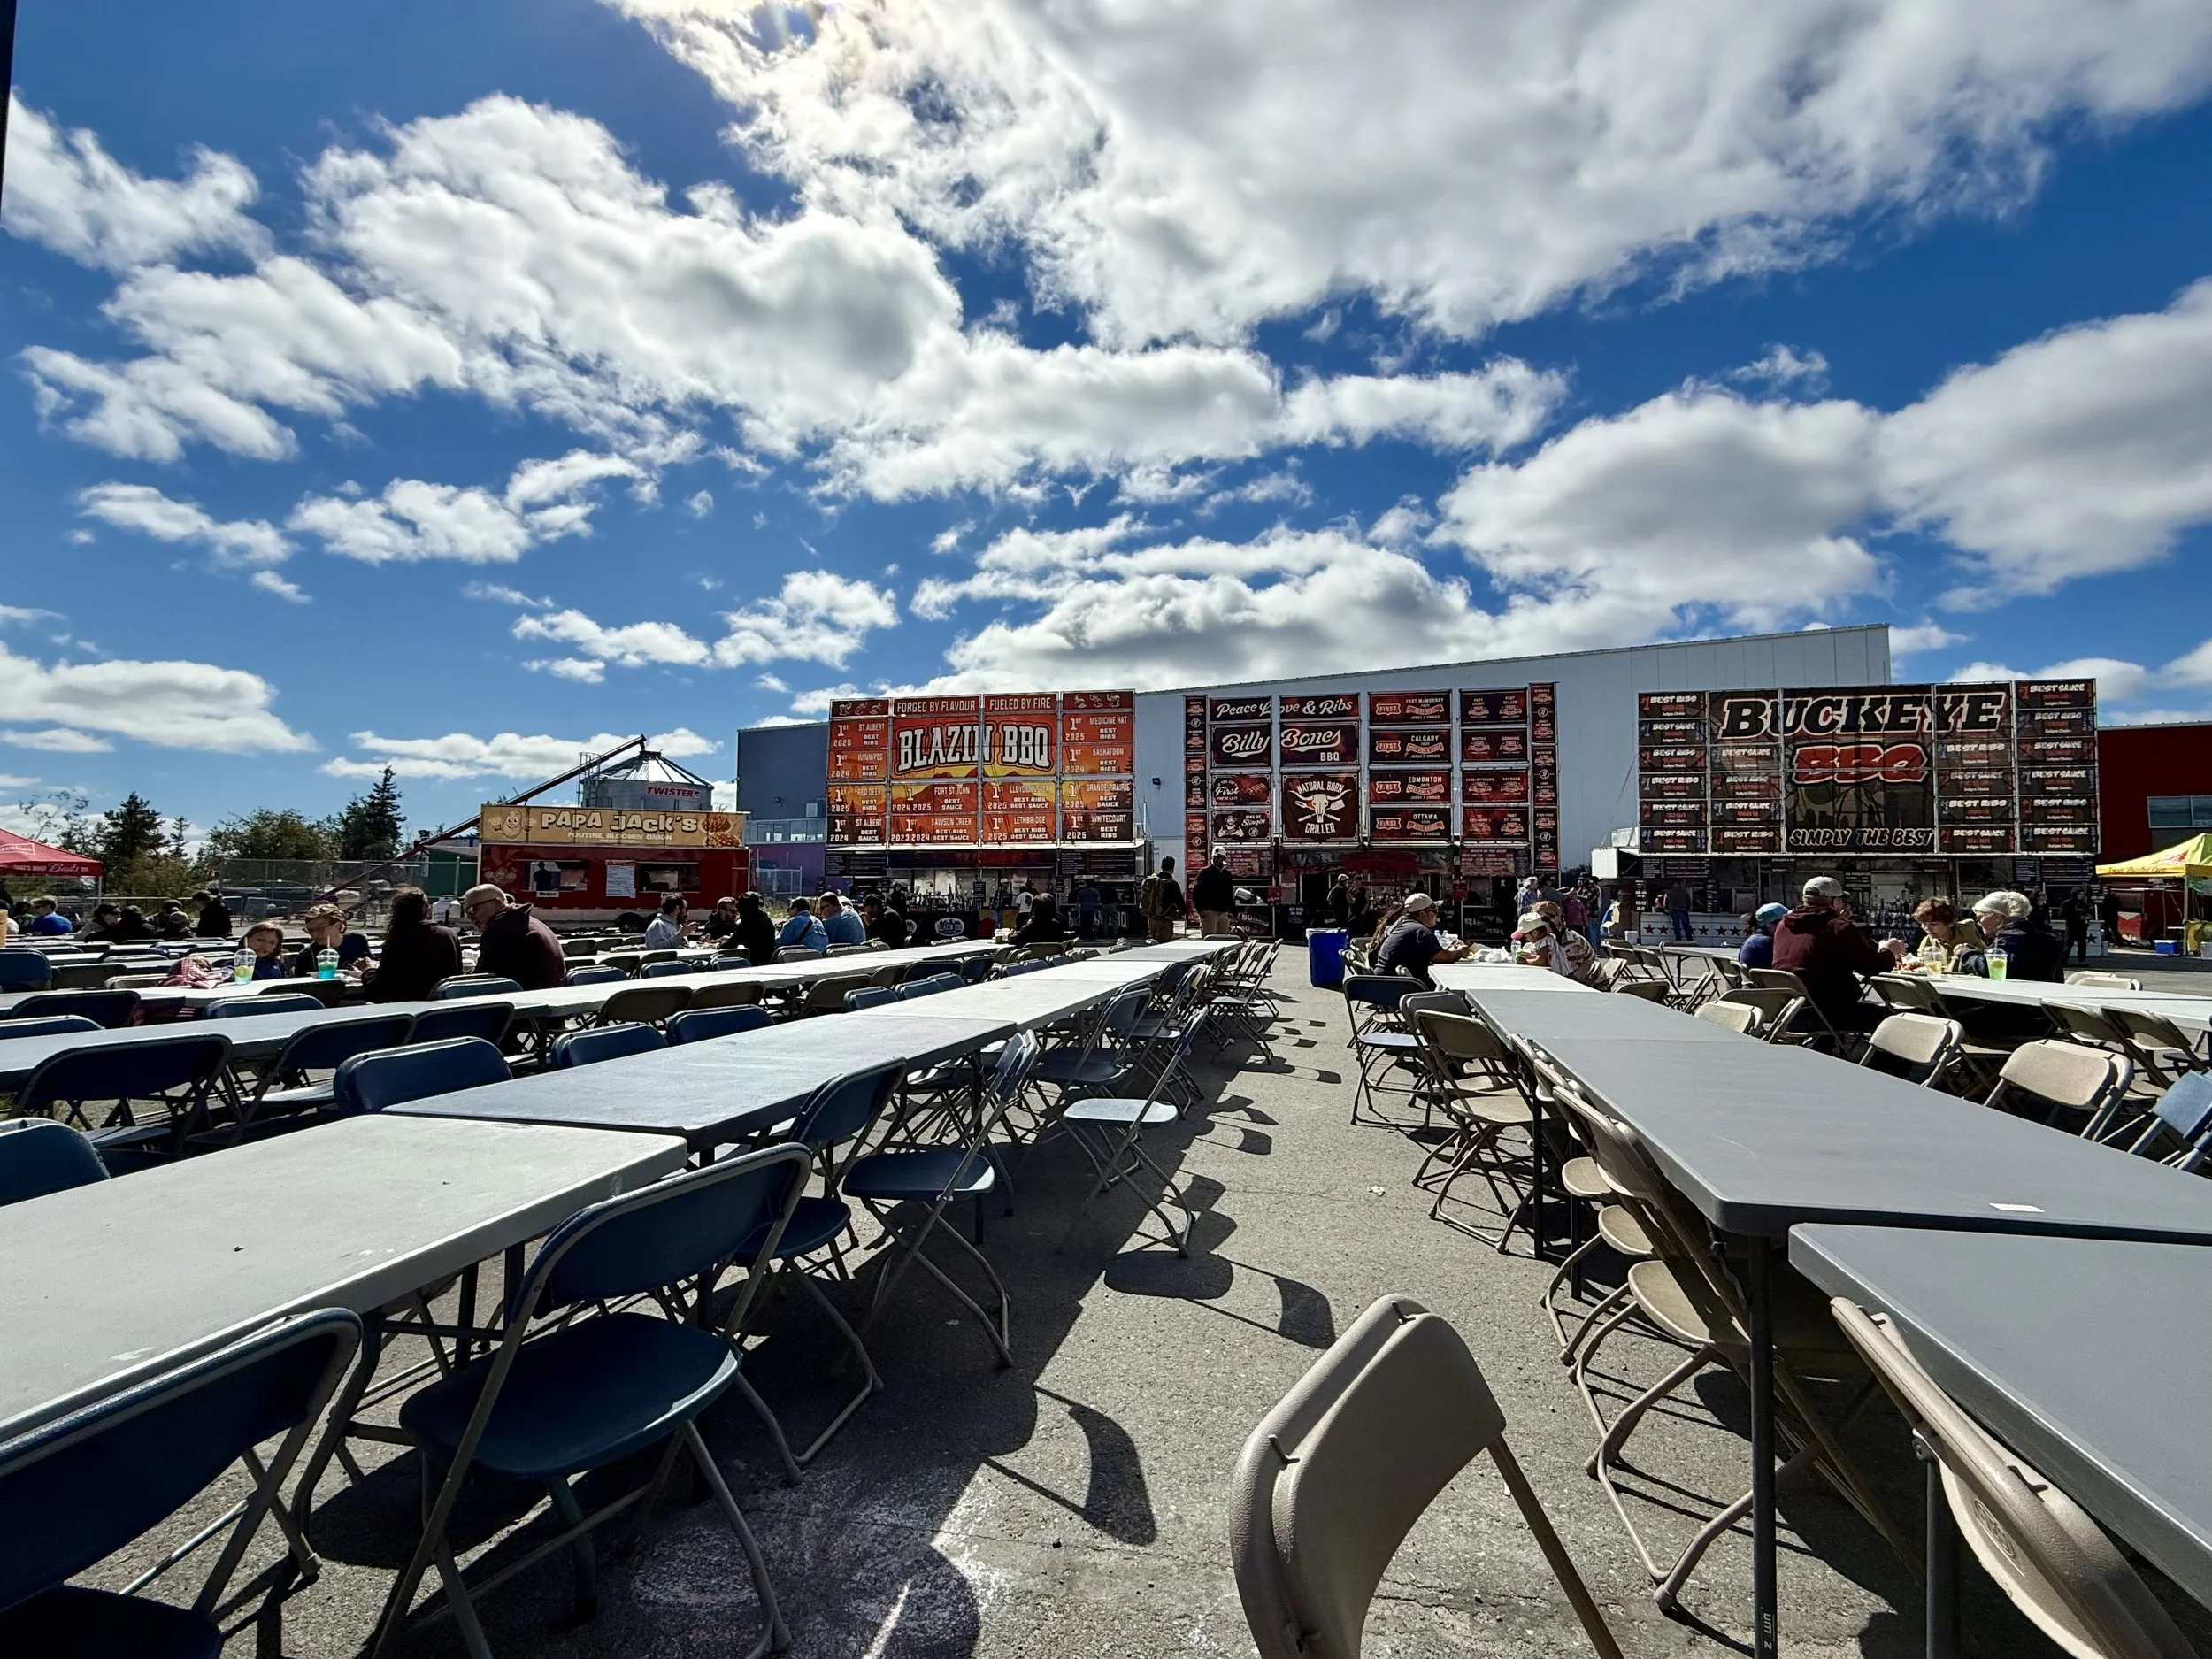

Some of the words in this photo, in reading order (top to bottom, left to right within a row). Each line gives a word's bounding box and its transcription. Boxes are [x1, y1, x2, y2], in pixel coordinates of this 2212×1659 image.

[897, 702, 927, 713] FORGED
[929, 701, 938, 712] BY
[941, 699, 975, 711] FLAVOUR
[989, 699, 1019, 710] FUELED
[1021, 697, 1030, 710] BY
[1033, 697, 1051, 710] FIRE
[1216, 703, 1257, 718] Peace
[1302, 700, 1317, 715] &
[1318, 698, 1354, 715] Ribs
[1717, 693, 2005, 740] BUCKEYE
[1221, 730, 1271, 757] Billy
[1280, 728, 1341, 752] Bones
[898, 726, 994, 772] BLAZIN
[1002, 726, 1049, 766] BBQ
[1320, 751, 1340, 761] BBQ
[1793, 744, 1928, 784] BBQ
[647, 787, 694, 797] TWISTER
[1215, 786, 1239, 796] First
[1296, 780, 1325, 795] NATURAL
[1327, 780, 1345, 793] BORN
[1304, 823, 1336, 834] GRILLER
[1789, 828, 1852, 846] SIMPLY
[1855, 828, 1890, 846] THE
[1892, 828, 1934, 846] BEST
